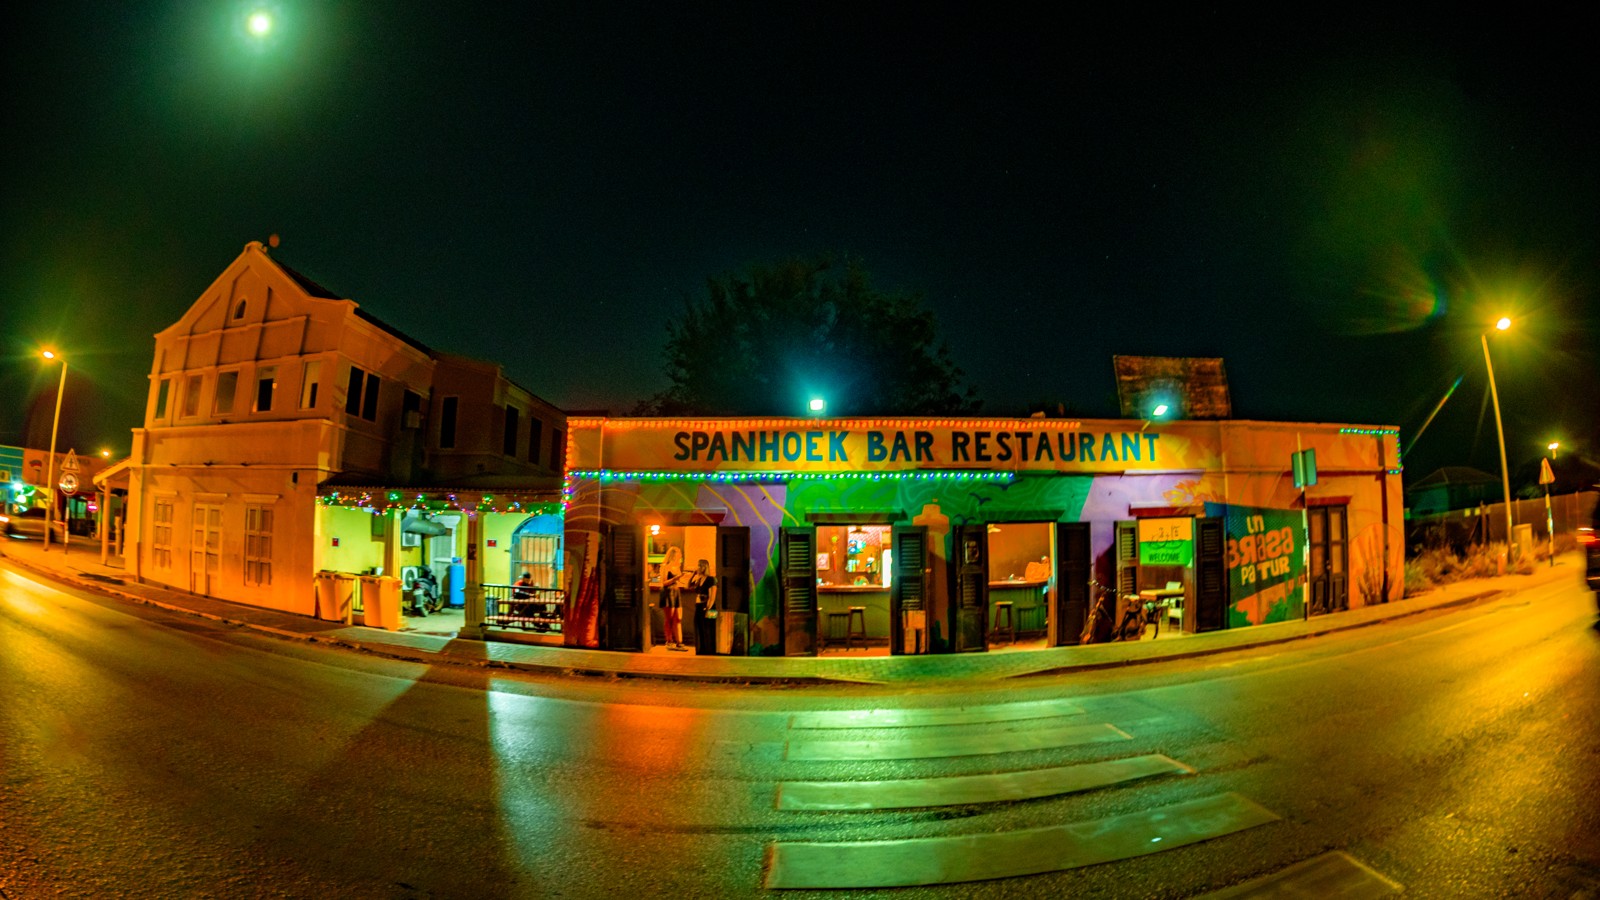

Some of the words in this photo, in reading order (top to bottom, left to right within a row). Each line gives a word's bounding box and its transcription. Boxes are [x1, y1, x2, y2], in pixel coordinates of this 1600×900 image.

[673, 430, 850, 462] SPANHOEK
[867, 430, 934, 462] BAR
[951, 431, 1160, 463] RESTAURANT
[1148, 552, 1180, 563] WELCOME
[1257, 556, 1291, 581] TUR
